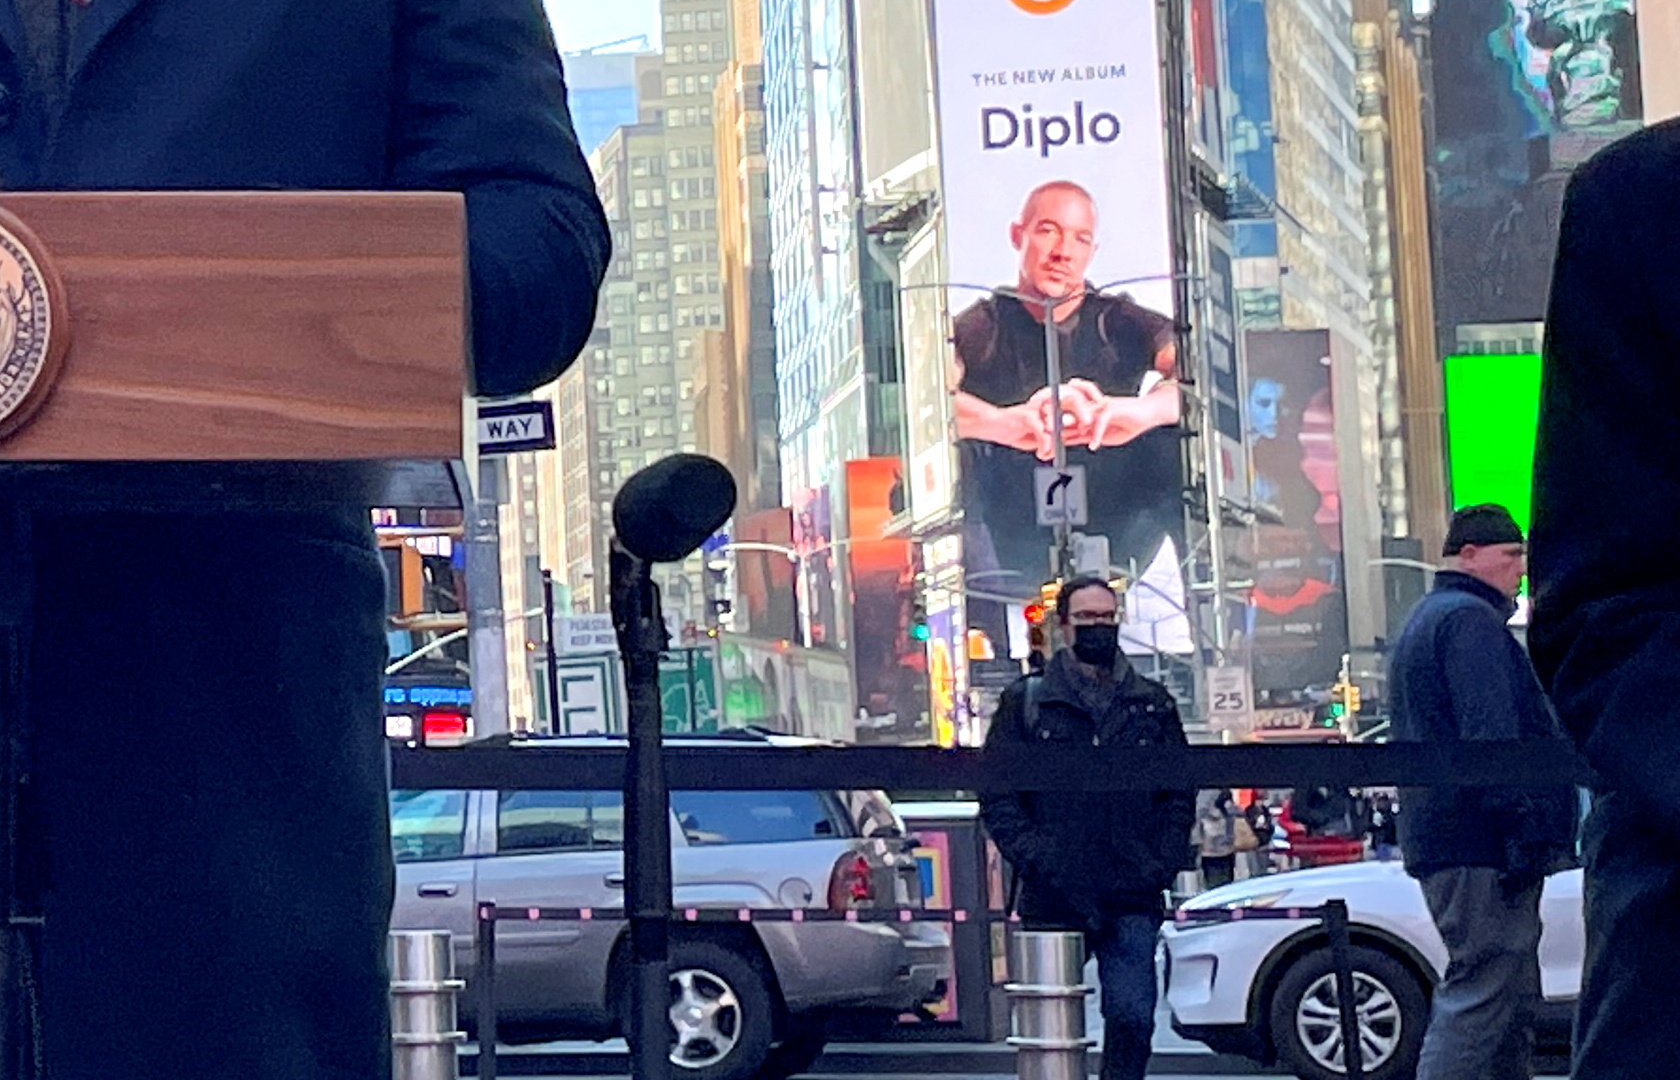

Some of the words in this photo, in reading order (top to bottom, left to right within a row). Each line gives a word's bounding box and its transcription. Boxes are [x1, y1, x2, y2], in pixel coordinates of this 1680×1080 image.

[971, 72, 1008, 87] THE
[1013, 69, 1056, 84] NEW
[1061, 64, 1127, 82] ALBUM
[981, 101, 1121, 159] Diplo
[487, 418, 532, 440] WAY
[1214, 693, 1244, 711] 25
